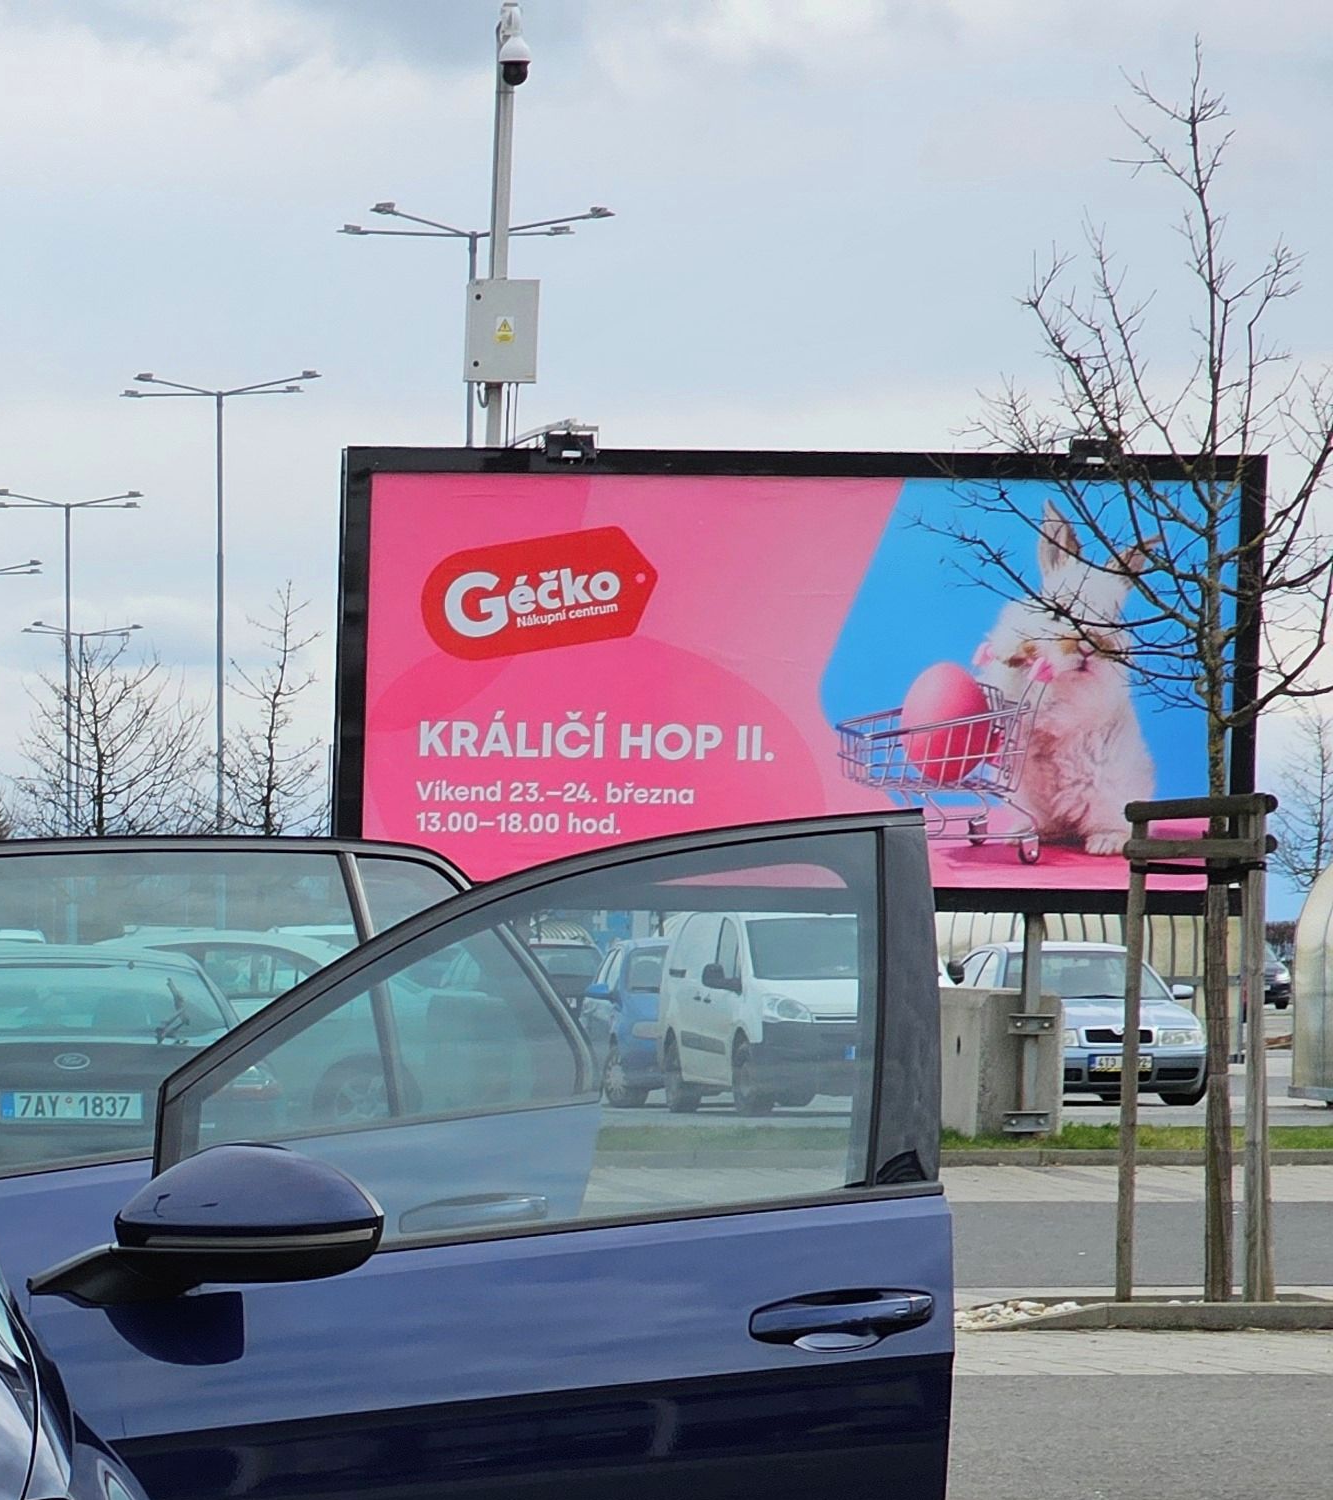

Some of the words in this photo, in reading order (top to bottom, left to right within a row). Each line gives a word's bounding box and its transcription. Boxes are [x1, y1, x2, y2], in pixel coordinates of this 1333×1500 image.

[444, 568, 621, 638] Géčko
[516, 610, 567, 628] Nákupní
[568, 603, 619, 620] centrum
[418, 710, 608, 759] KRÁLIČÍ
[619, 723, 724, 760] HOP
[736, 725, 775, 762] II.
[416, 781, 502, 802] Víkend
[509, 782, 598, 803] 23.–24.
[606, 783, 695, 804] března
[416, 812, 559, 833] 13.00–18.00
[567, 814, 622, 834] hod.
[20, 1095, 60, 1117] 7AY
[78, 1096, 131, 1117] 1837
